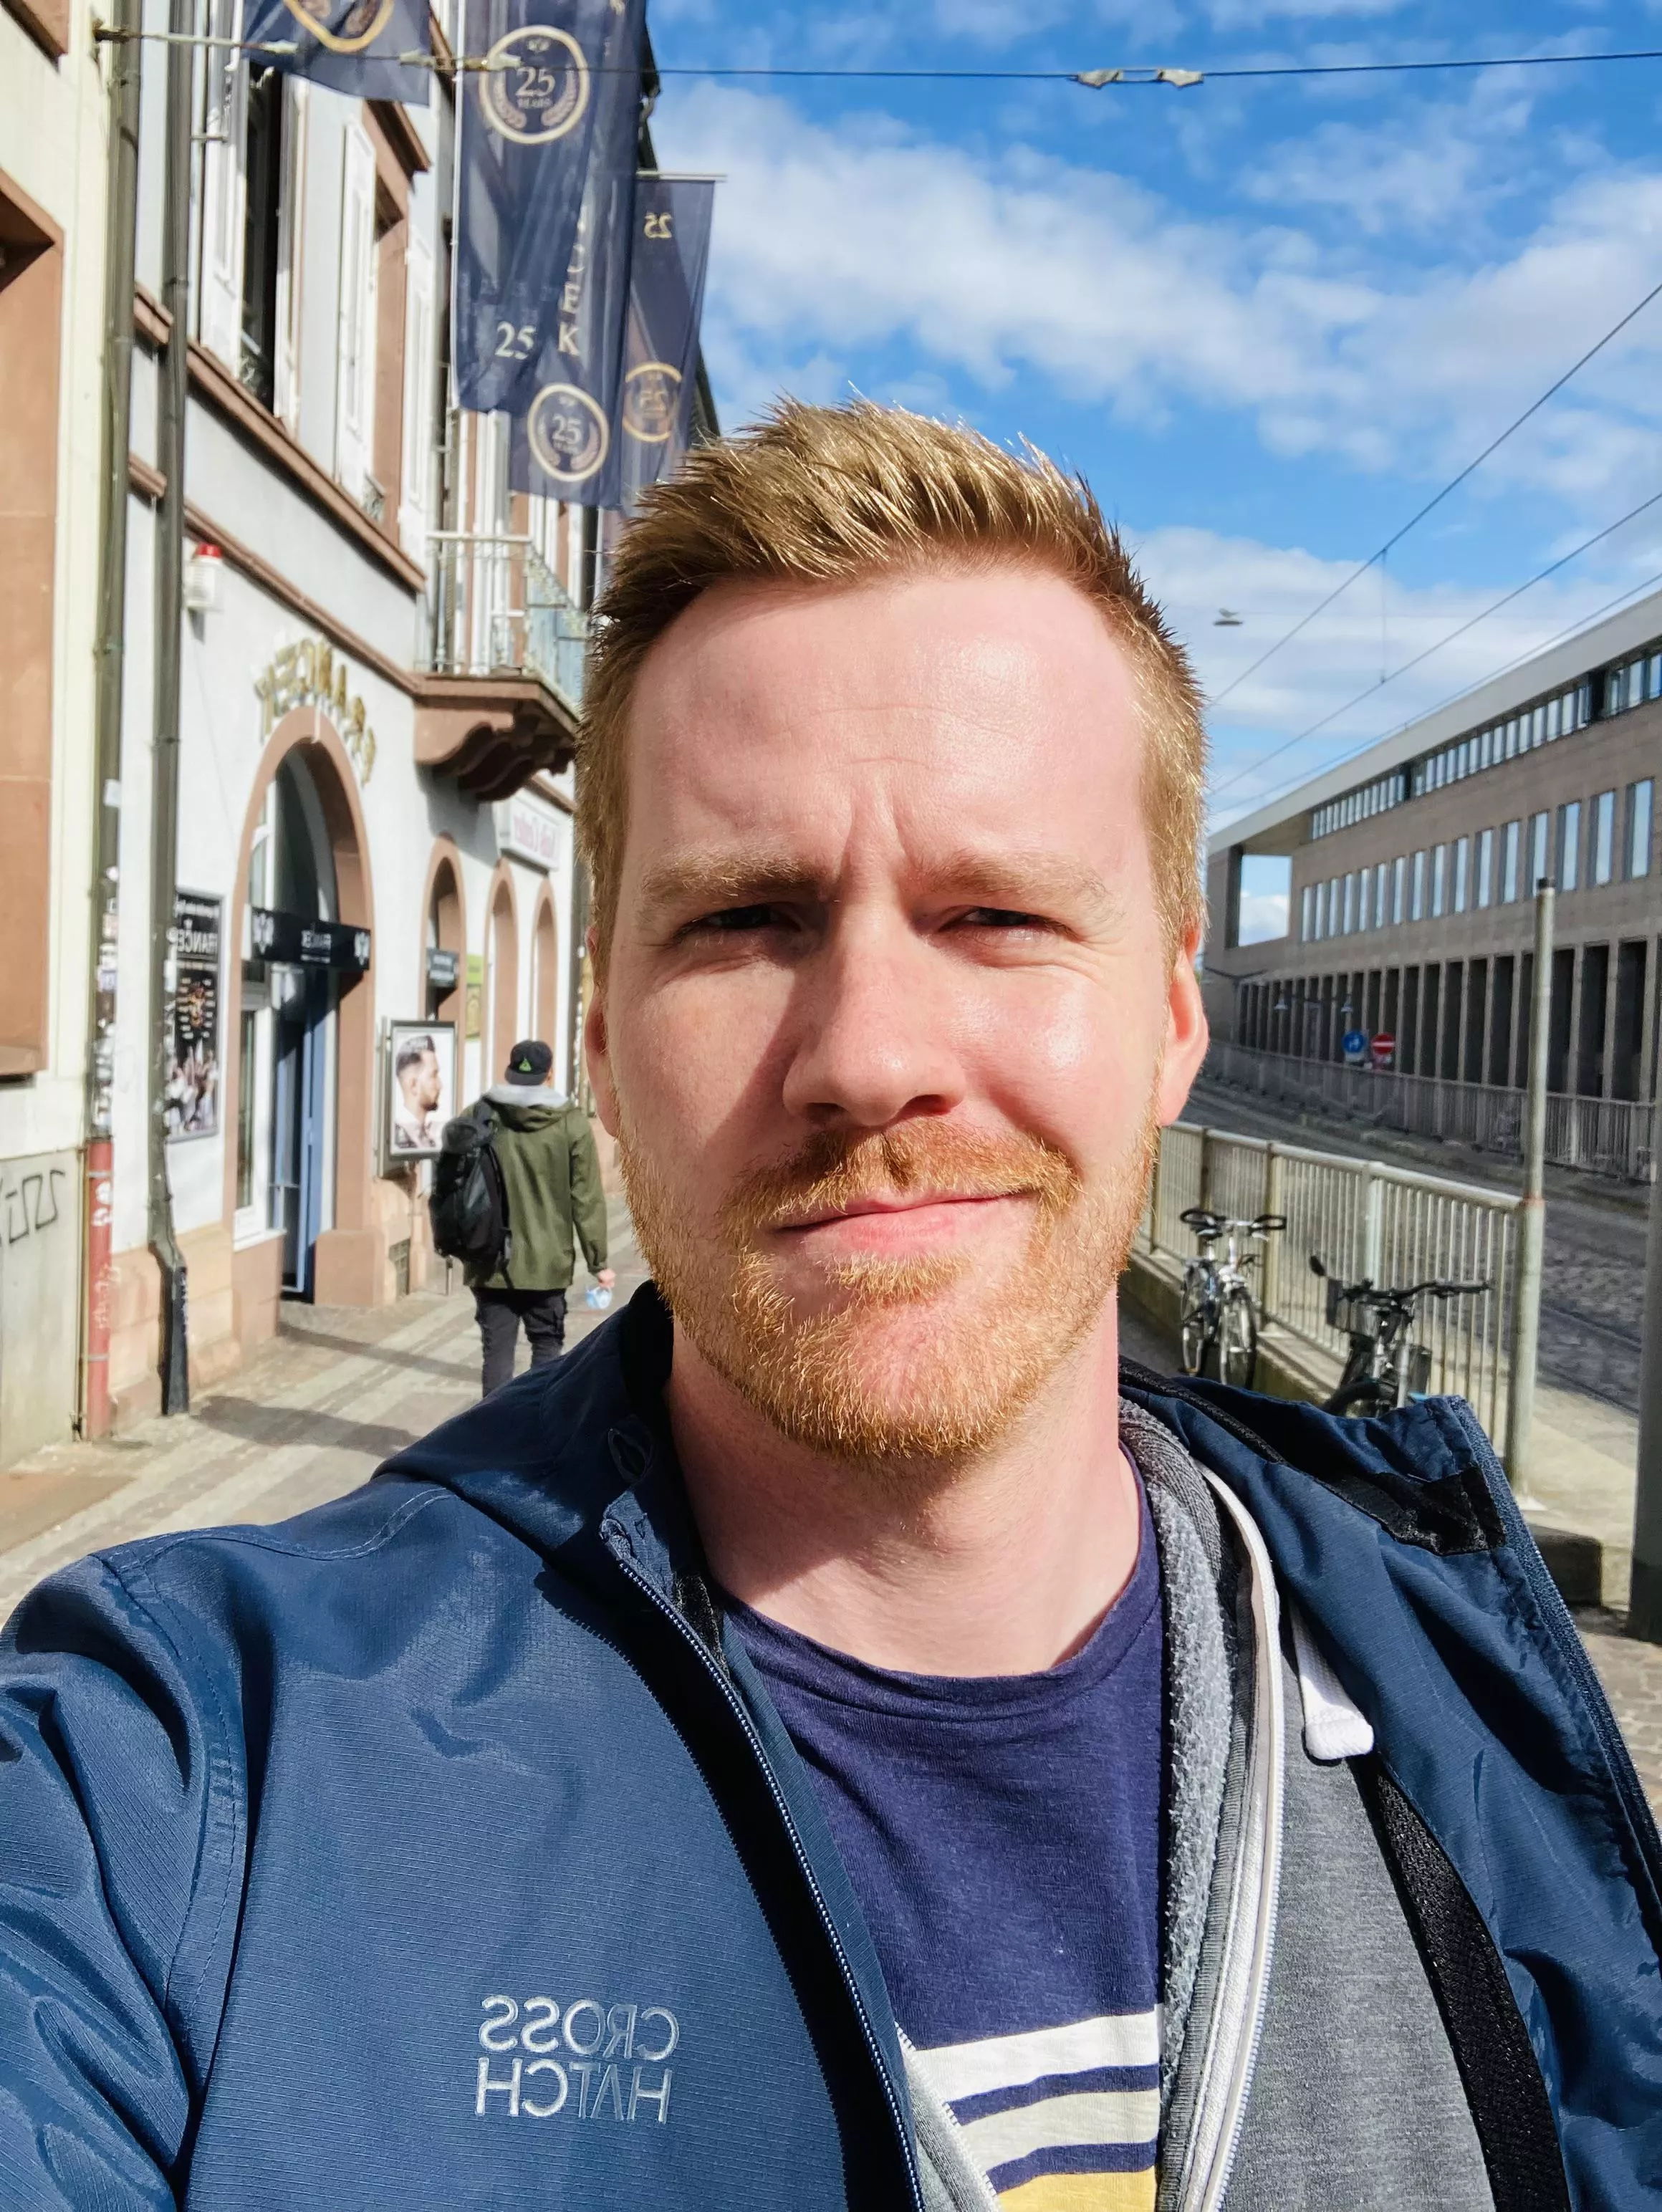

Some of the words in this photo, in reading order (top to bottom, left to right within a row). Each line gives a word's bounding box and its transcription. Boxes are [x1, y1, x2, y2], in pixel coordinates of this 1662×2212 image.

[516, 66, 555, 97] 25
[496, 322, 536, 360] 25
[552, 414, 583, 446] 25
